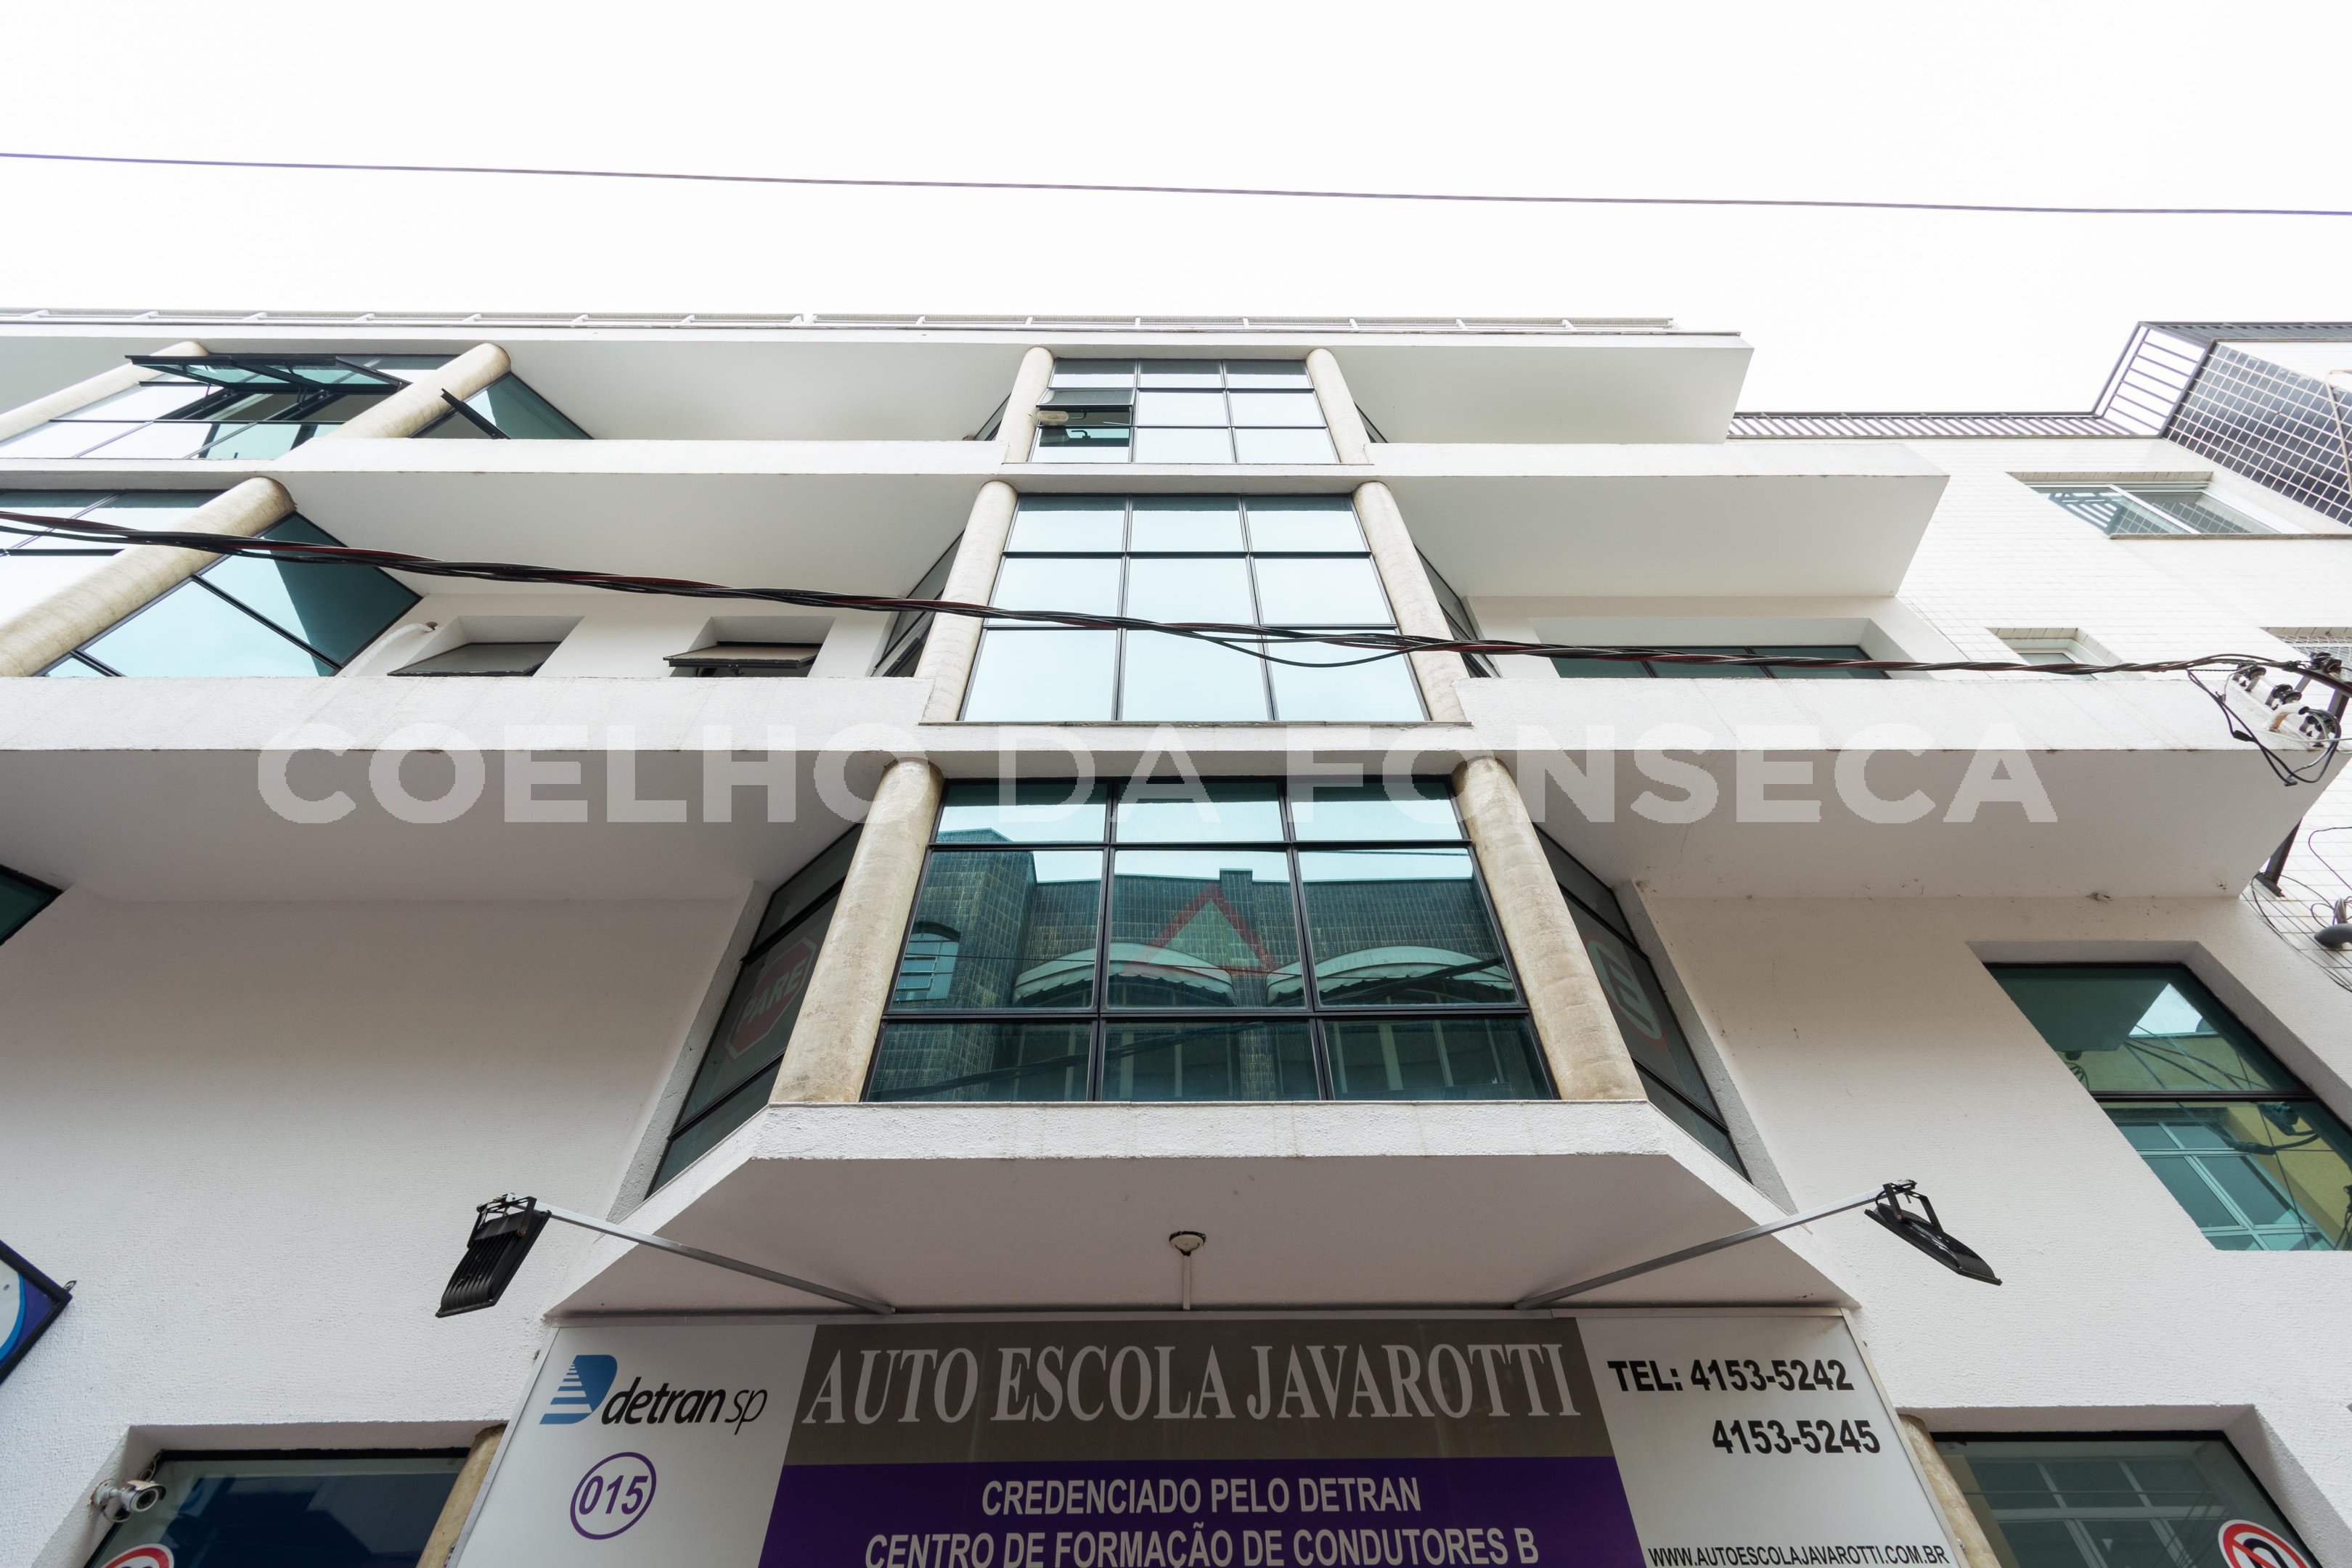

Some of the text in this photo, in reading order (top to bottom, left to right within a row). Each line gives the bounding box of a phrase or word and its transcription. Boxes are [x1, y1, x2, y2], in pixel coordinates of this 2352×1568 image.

[735, 957, 807, 1034] PARE
[801, 1343, 1581, 1424] AUTO ESCOLA JAVAROTTI
[1606, 1358, 1855, 1392] TEL: 4153-5242
[601, 1376, 768, 1436] detran sp
[1712, 1418, 1881, 1455] 4153-5245
[579, 1475, 649, 1516] 015
[981, 1477, 1421, 1516] CREDENCIADO PELO DETRAN
[865, 1532, 995, 1568] CENTRO
[1003, 1532, 1046, 1568] DE
[1243, 1529, 1285, 1567] DE
[1293, 1527, 1509, 1567] CONDUTORES
[1515, 1527, 1540, 1564] B
[1647, 1545, 1950, 1567] WWW.AUTOESCOLAJAVAROTTI.COM.BR
